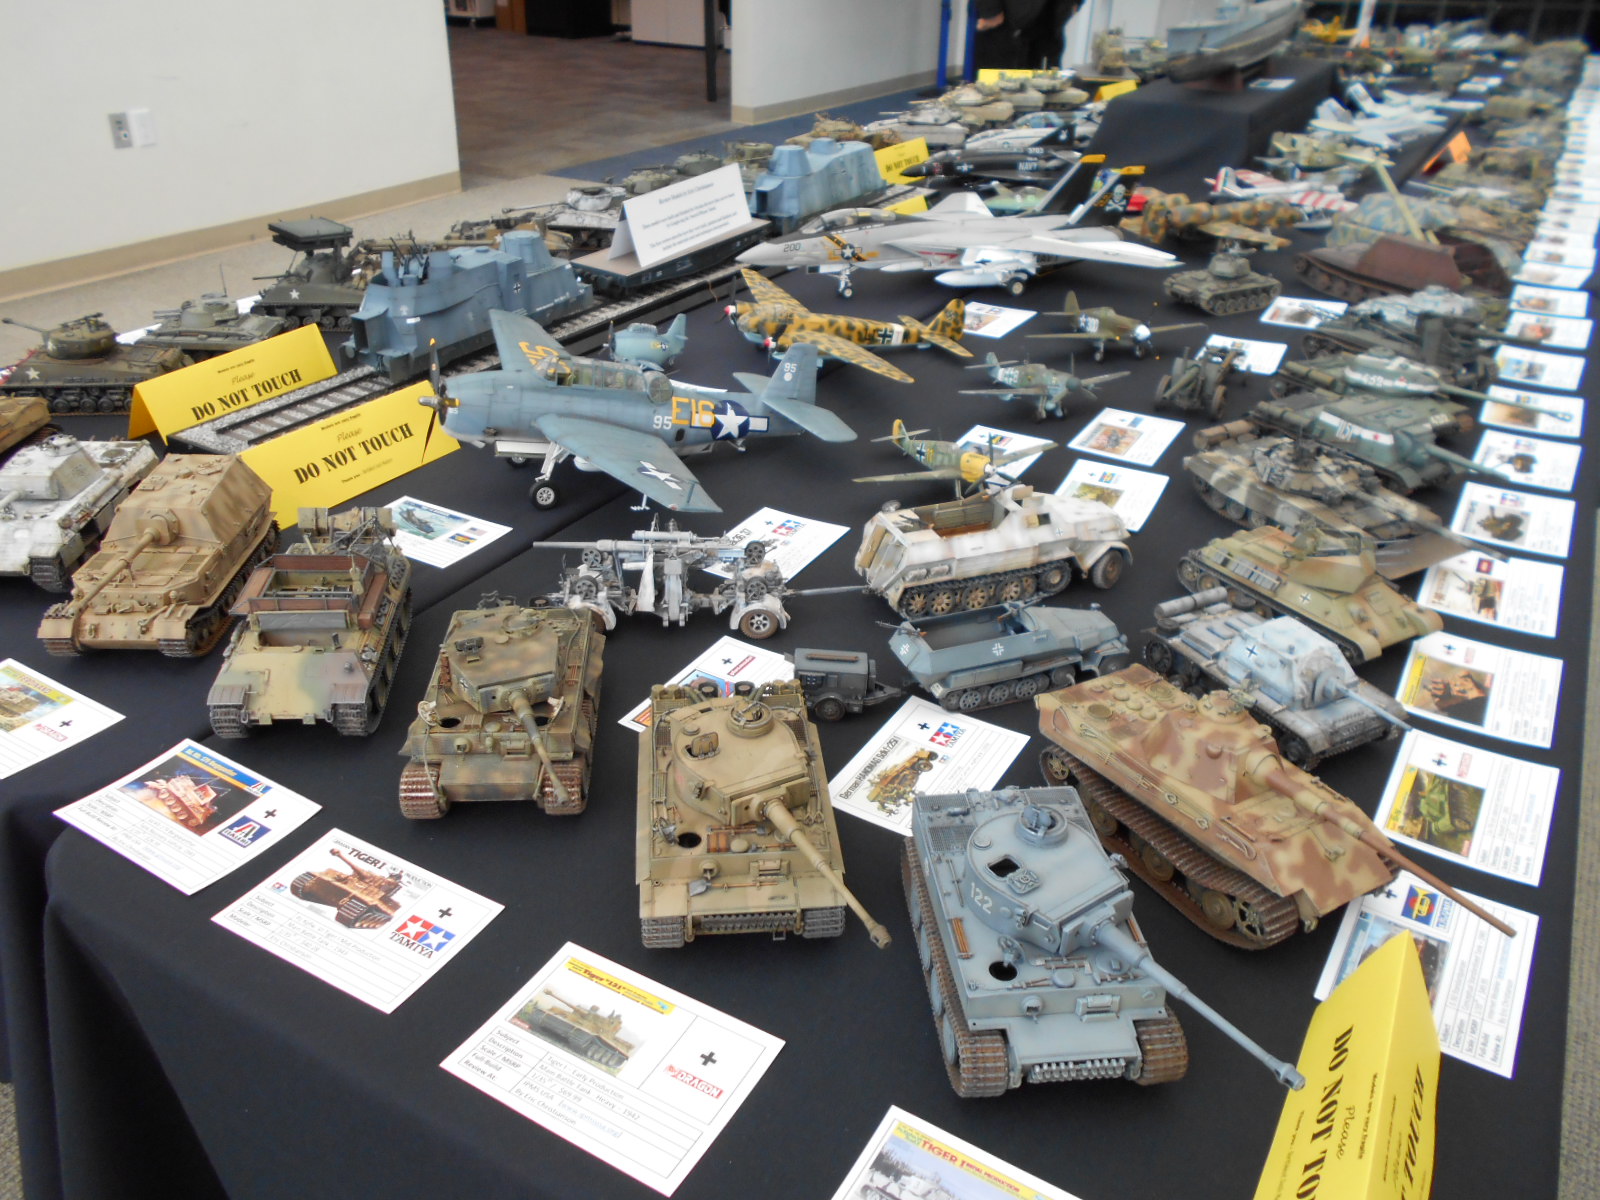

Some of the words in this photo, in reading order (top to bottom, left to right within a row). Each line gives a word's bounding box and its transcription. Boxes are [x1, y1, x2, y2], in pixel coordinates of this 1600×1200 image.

[1018, 162, 1039, 171] NAVY
[231, 372, 255, 385] Please
[783, 362, 797, 373] 95
[191, 402, 216, 421] DO
[217, 388, 250, 412] NOT
[251, 369, 303, 397] TOUCH
[652, 415, 672, 430] 95
[672, 396, 716, 428] E16
[336, 428, 363, 442] Please
[293, 462, 320, 485] DO
[322, 446, 358, 472] NOT
[358, 422, 414, 456] TOUCH
[348, 847, 381, 869] TIGER
[971, 882, 993, 914] 122
[389, 931, 435, 959] TAMIYA
[583, 967, 605, 982] Tiger
[488, 1037, 523, 1059] Description
[496, 1030, 520, 1045] Subject
[1329, 1024, 1354, 1072] DO
[480, 1044, 497, 1056] Scale
[463, 1059, 487, 1076] Review
[677, 1069, 722, 1099] DRAGON
[1310, 1074, 1344, 1145] NOT
[1337, 1105, 1356, 1160] Please
[921, 1139, 958, 1164] TIGER
[1296, 1149, 1328, 1200] TO
